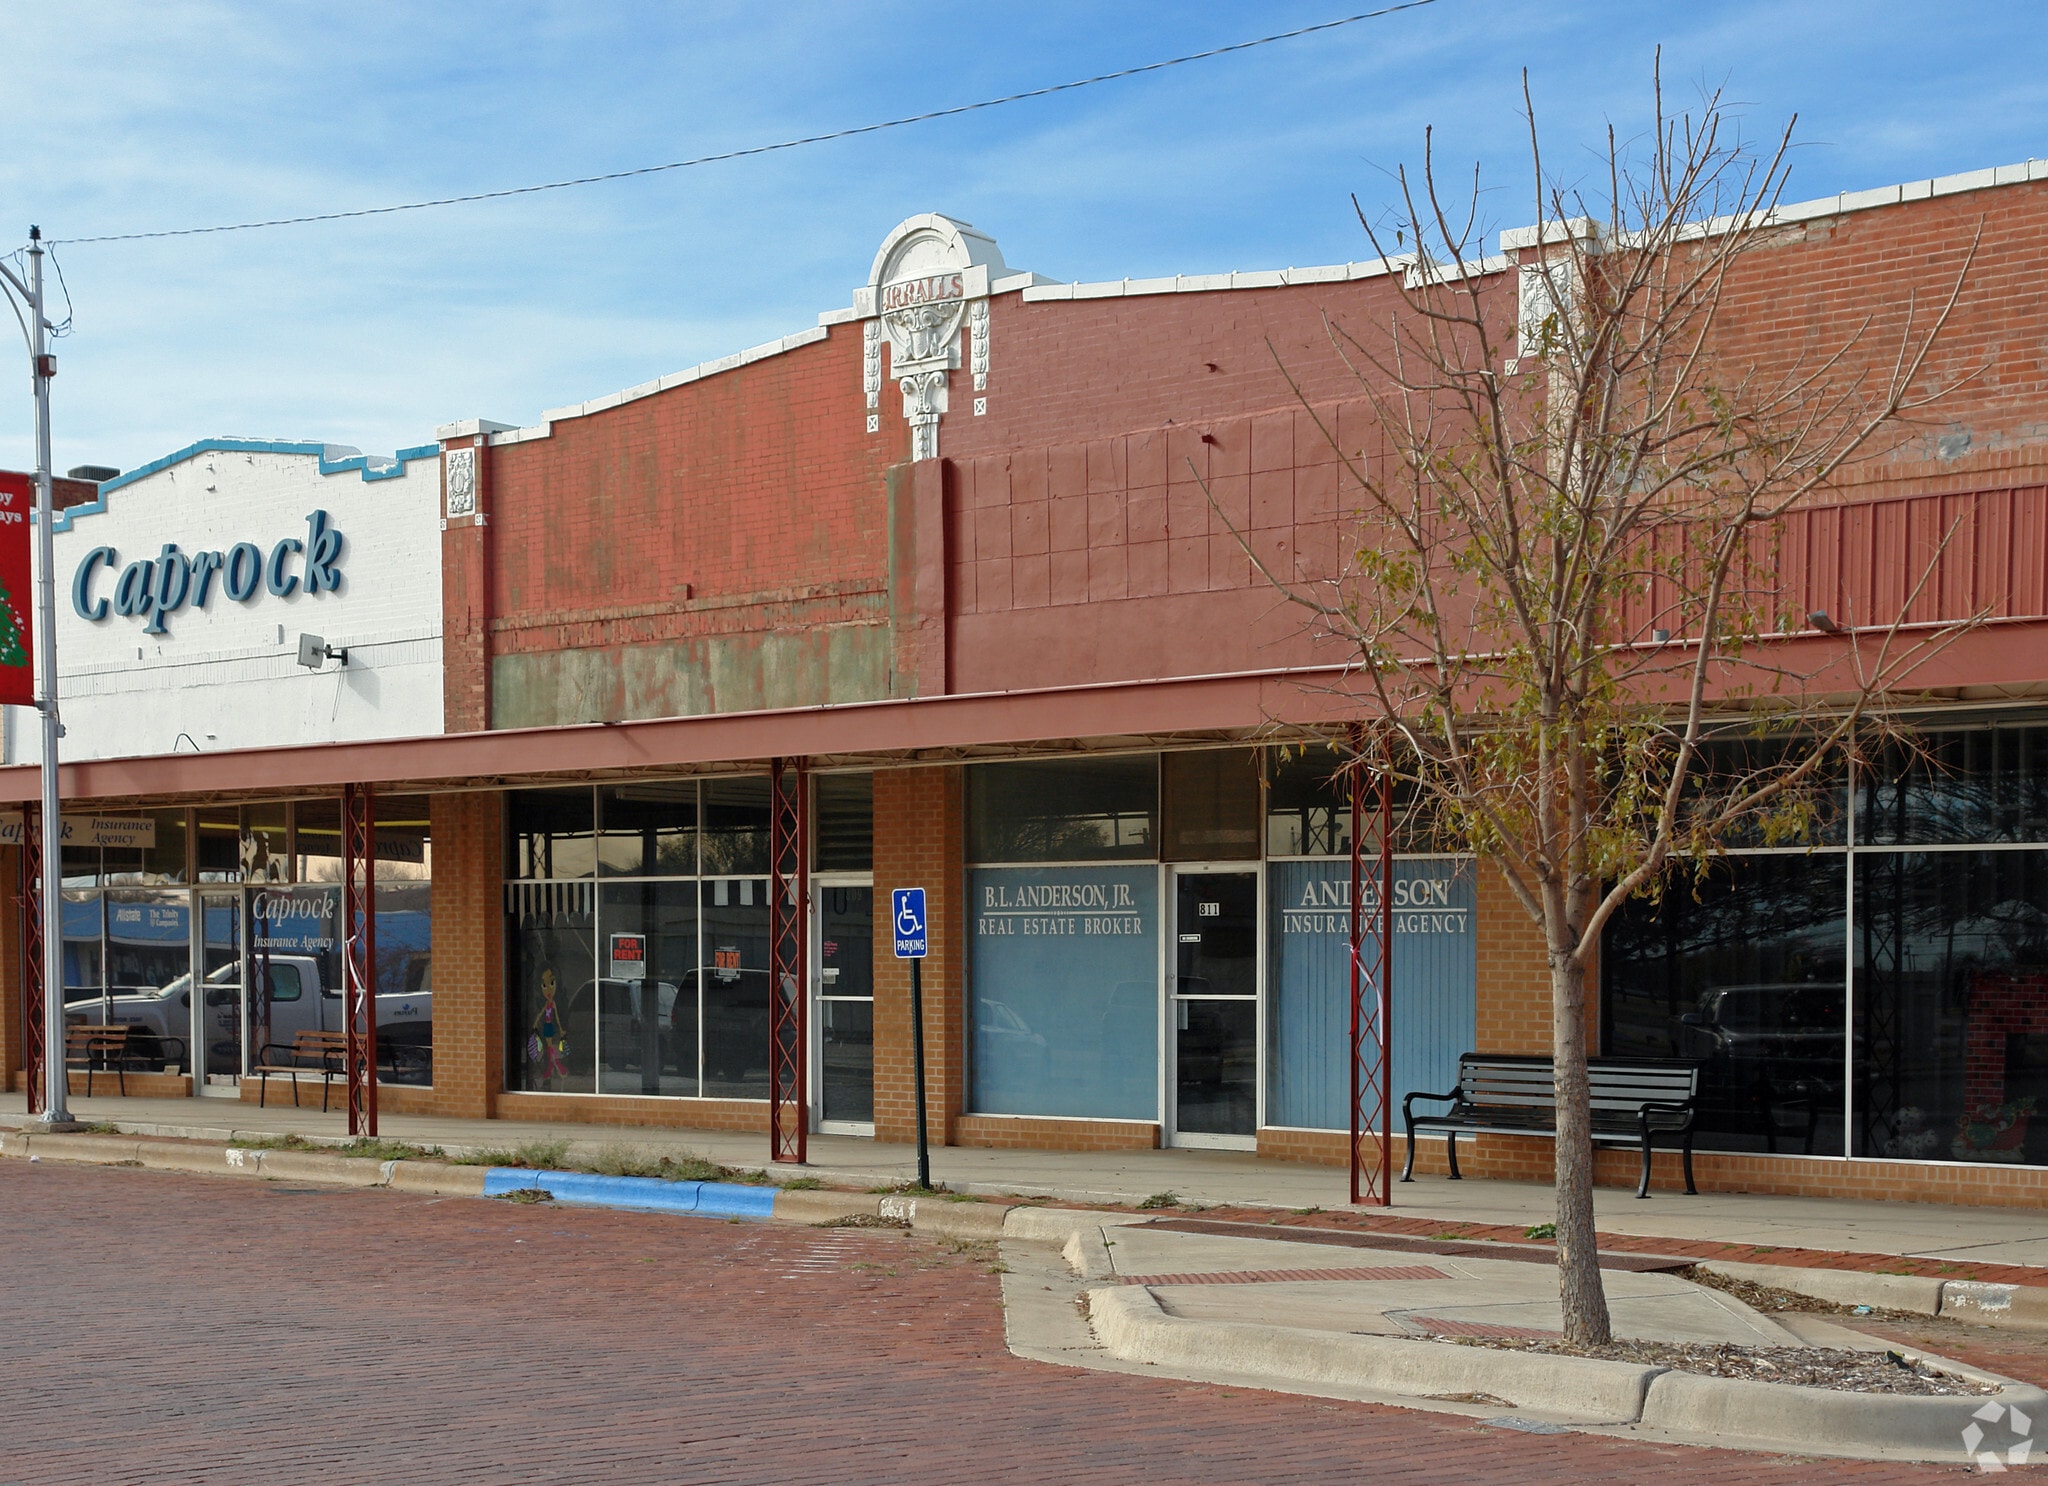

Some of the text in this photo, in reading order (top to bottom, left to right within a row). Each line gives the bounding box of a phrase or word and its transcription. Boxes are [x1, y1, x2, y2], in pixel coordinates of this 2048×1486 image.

[72, 509, 342, 634] Caprock
[91, 818, 152, 832] Insurance
[91, 832, 136, 847] Agency
[985, 884, 1135, 910] B.L. ANDERSON, JR.
[252, 891, 334, 928] Caprock
[1200, 904, 1218, 915] 811
[979, 917, 1142, 935] REAL ESTATE BROKER
[1396, 914, 1467, 933] AGENCY
[254, 935, 334, 952] Insurance Agency
[618, 938, 638, 949] FOR
[897, 939, 925, 952] PARKING
[613, 949, 642, 960] RENT
